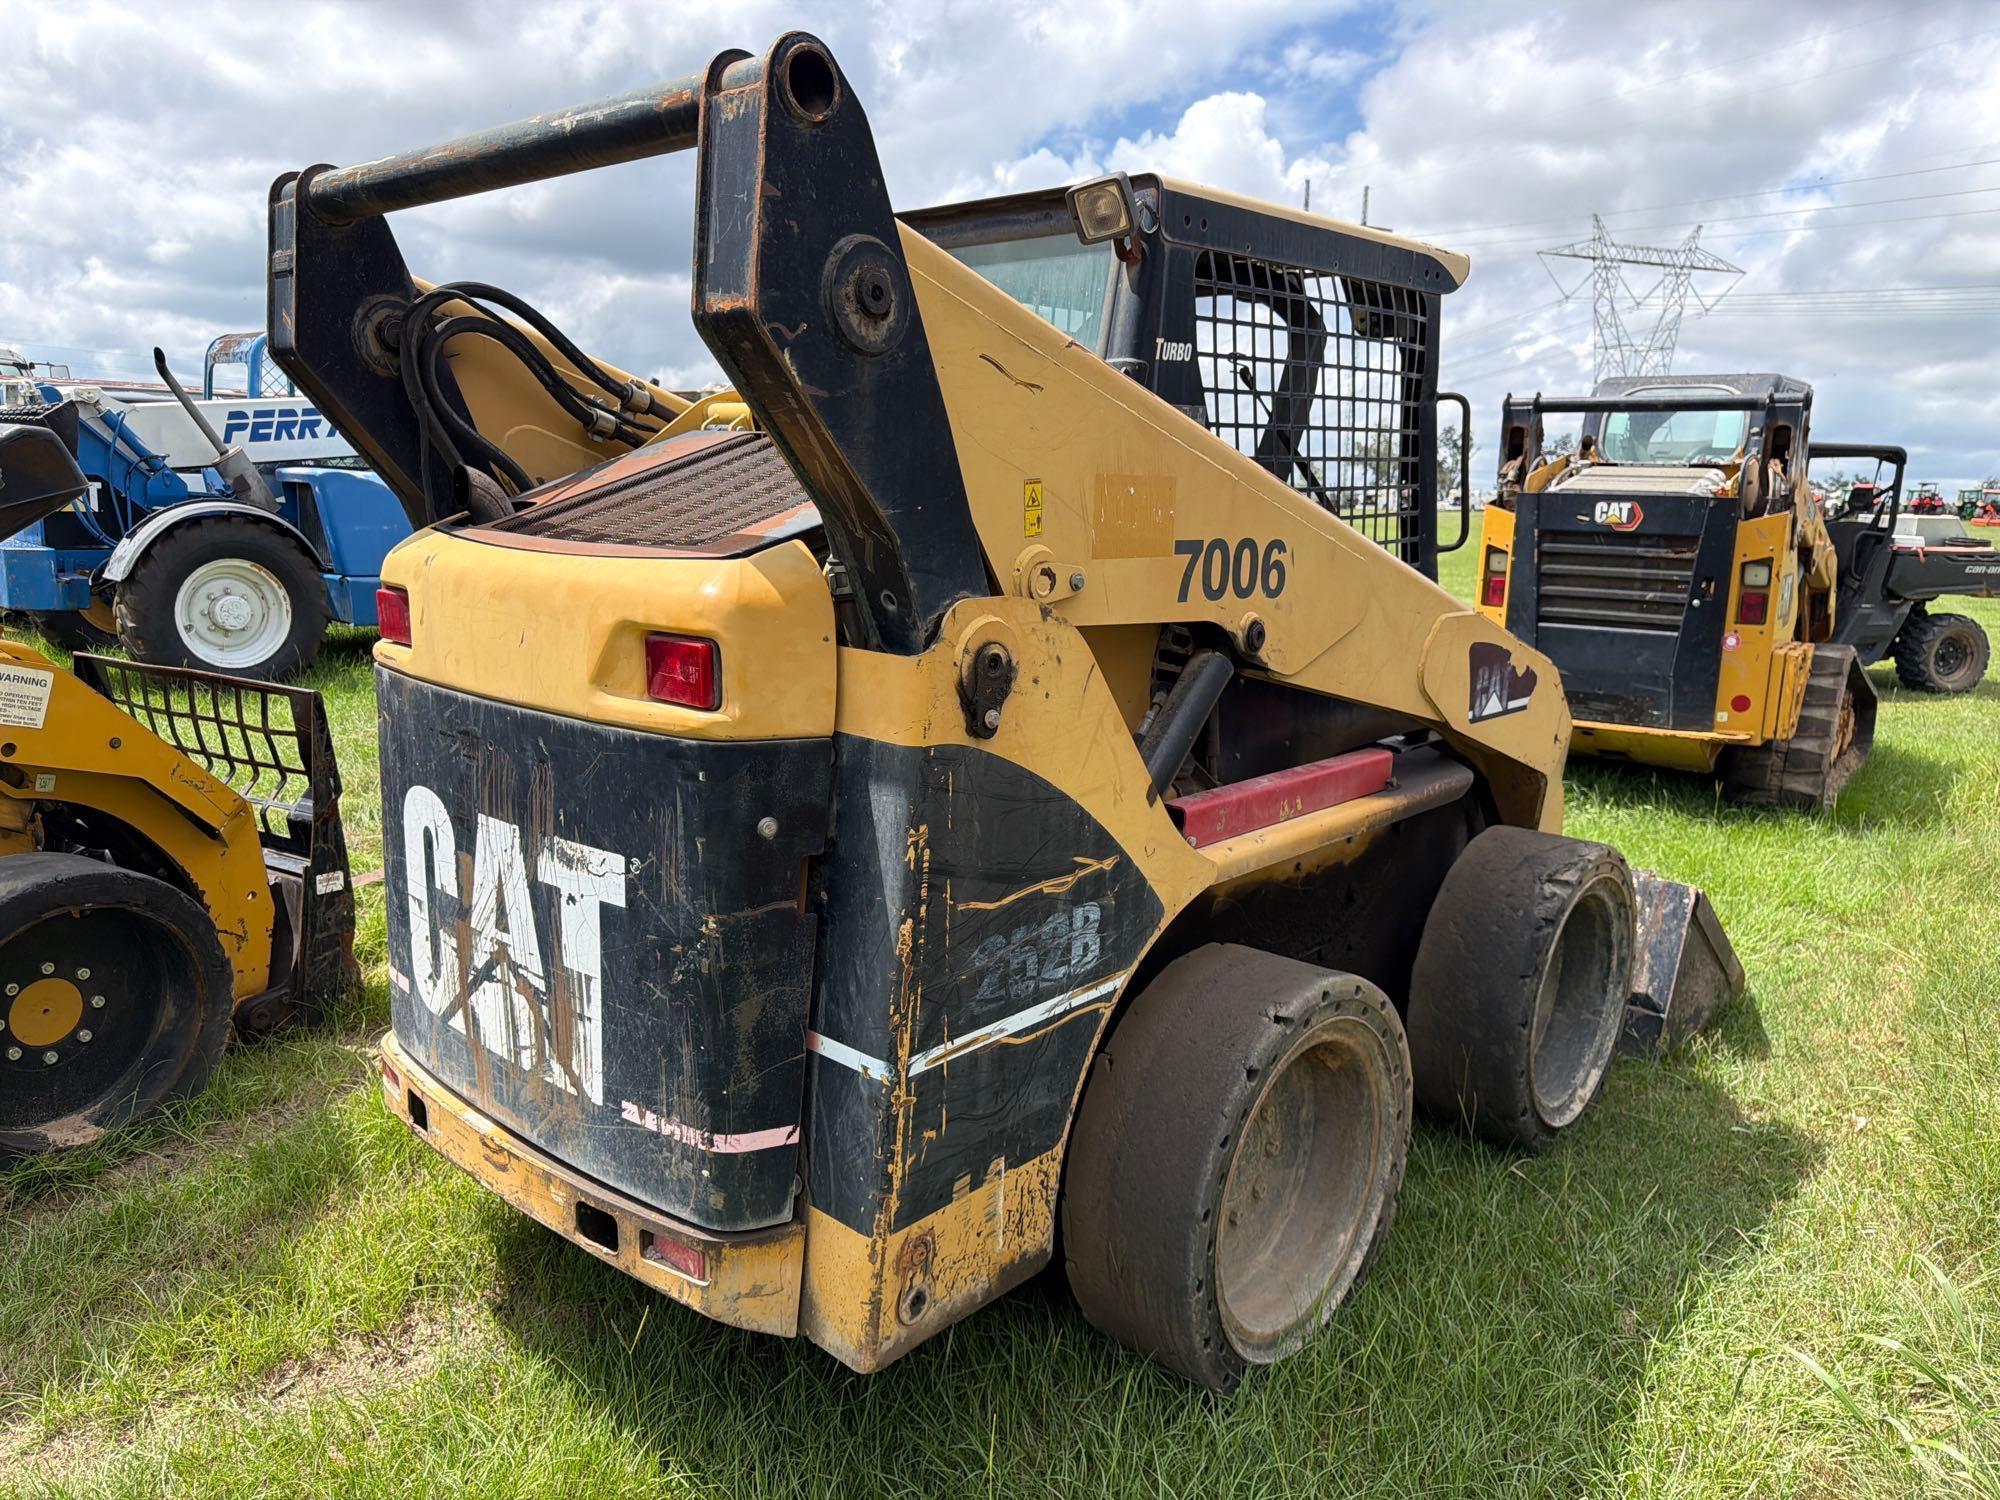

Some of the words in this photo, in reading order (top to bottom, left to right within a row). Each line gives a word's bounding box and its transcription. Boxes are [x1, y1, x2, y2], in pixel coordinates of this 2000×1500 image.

[1594, 501, 1632, 525] CAT
[1174, 537, 1287, 603] 7006
[4, 691, 30, 701] OPERATE
[404, 785, 625, 1106] CAT
